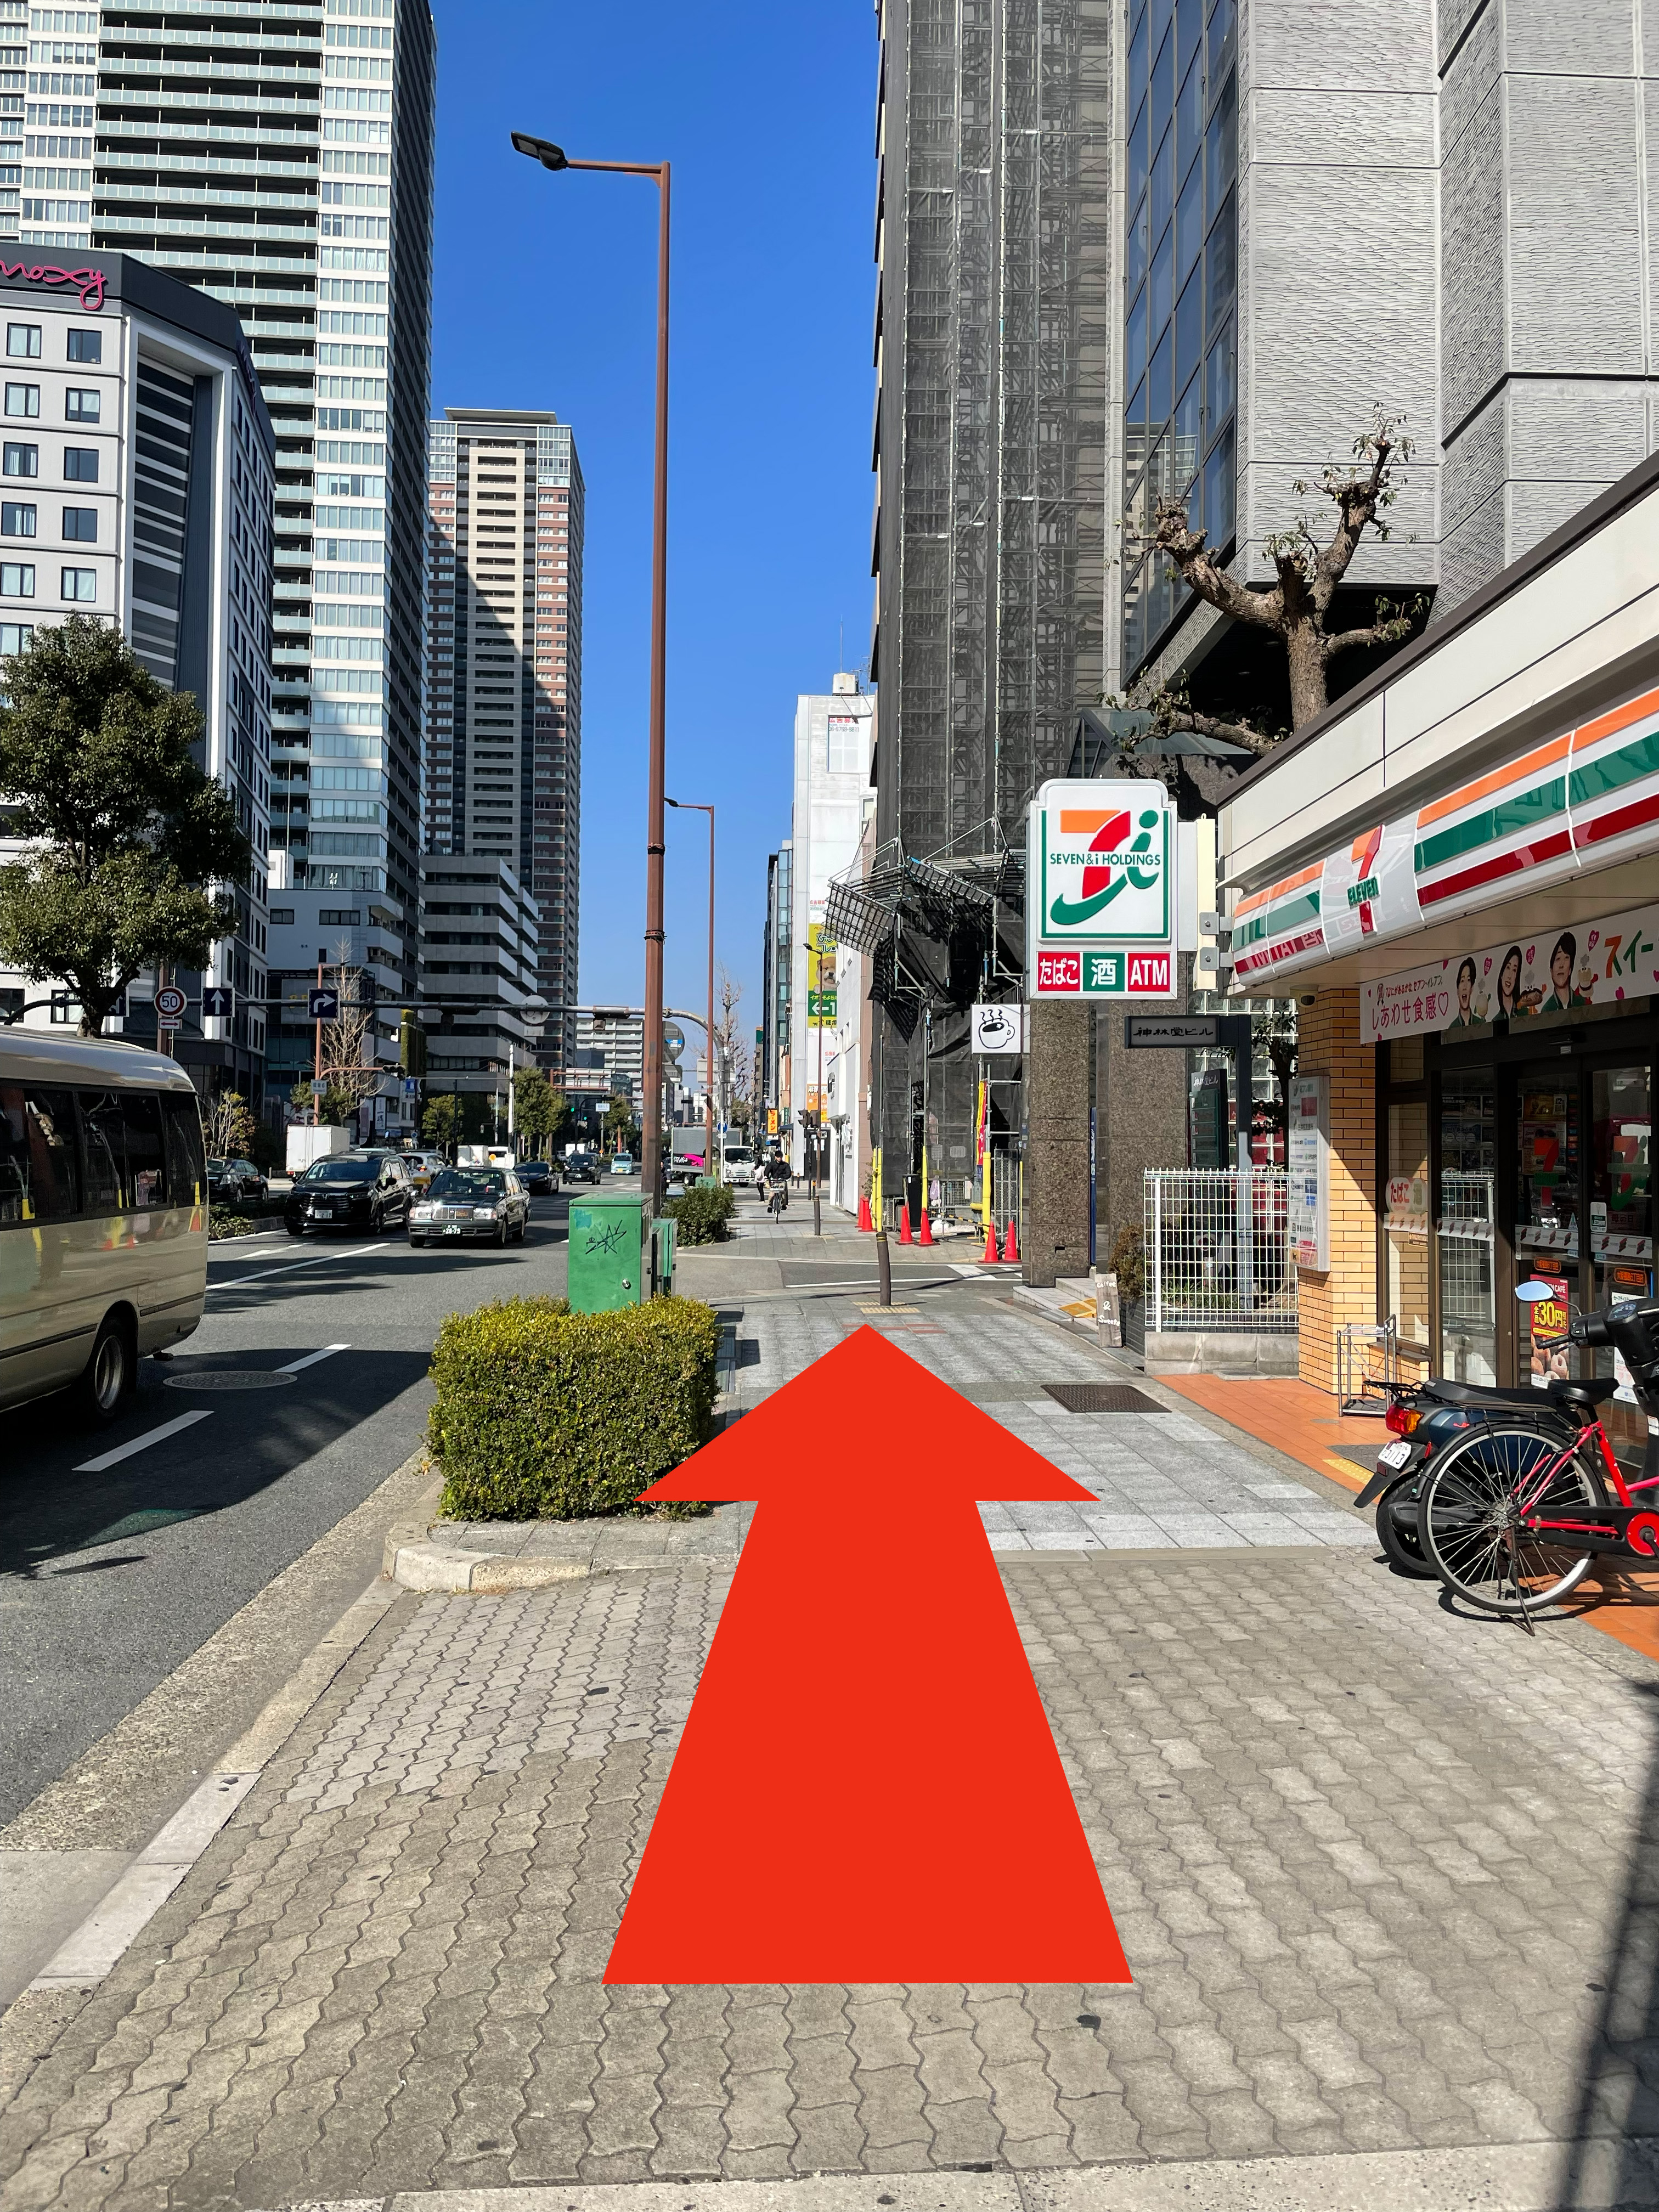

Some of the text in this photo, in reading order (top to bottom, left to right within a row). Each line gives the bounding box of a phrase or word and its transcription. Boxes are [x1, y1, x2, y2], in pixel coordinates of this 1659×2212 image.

[1050, 853, 1161, 866] SEVEN&i HOLDINGS
[1604, 929, 1659, 979] スイー
[1040, 958, 1079, 985] たばこ
[1091, 958, 1117, 986] 酒
[1131, 960, 1167, 986] ATM
[162, 995, 178, 1008] 50
[1133, 1026, 1214, 1037] 神林堂ビル
[1391, 1182, 1410, 1204] たばこ
[1103, 1300, 1111, 1311] &
